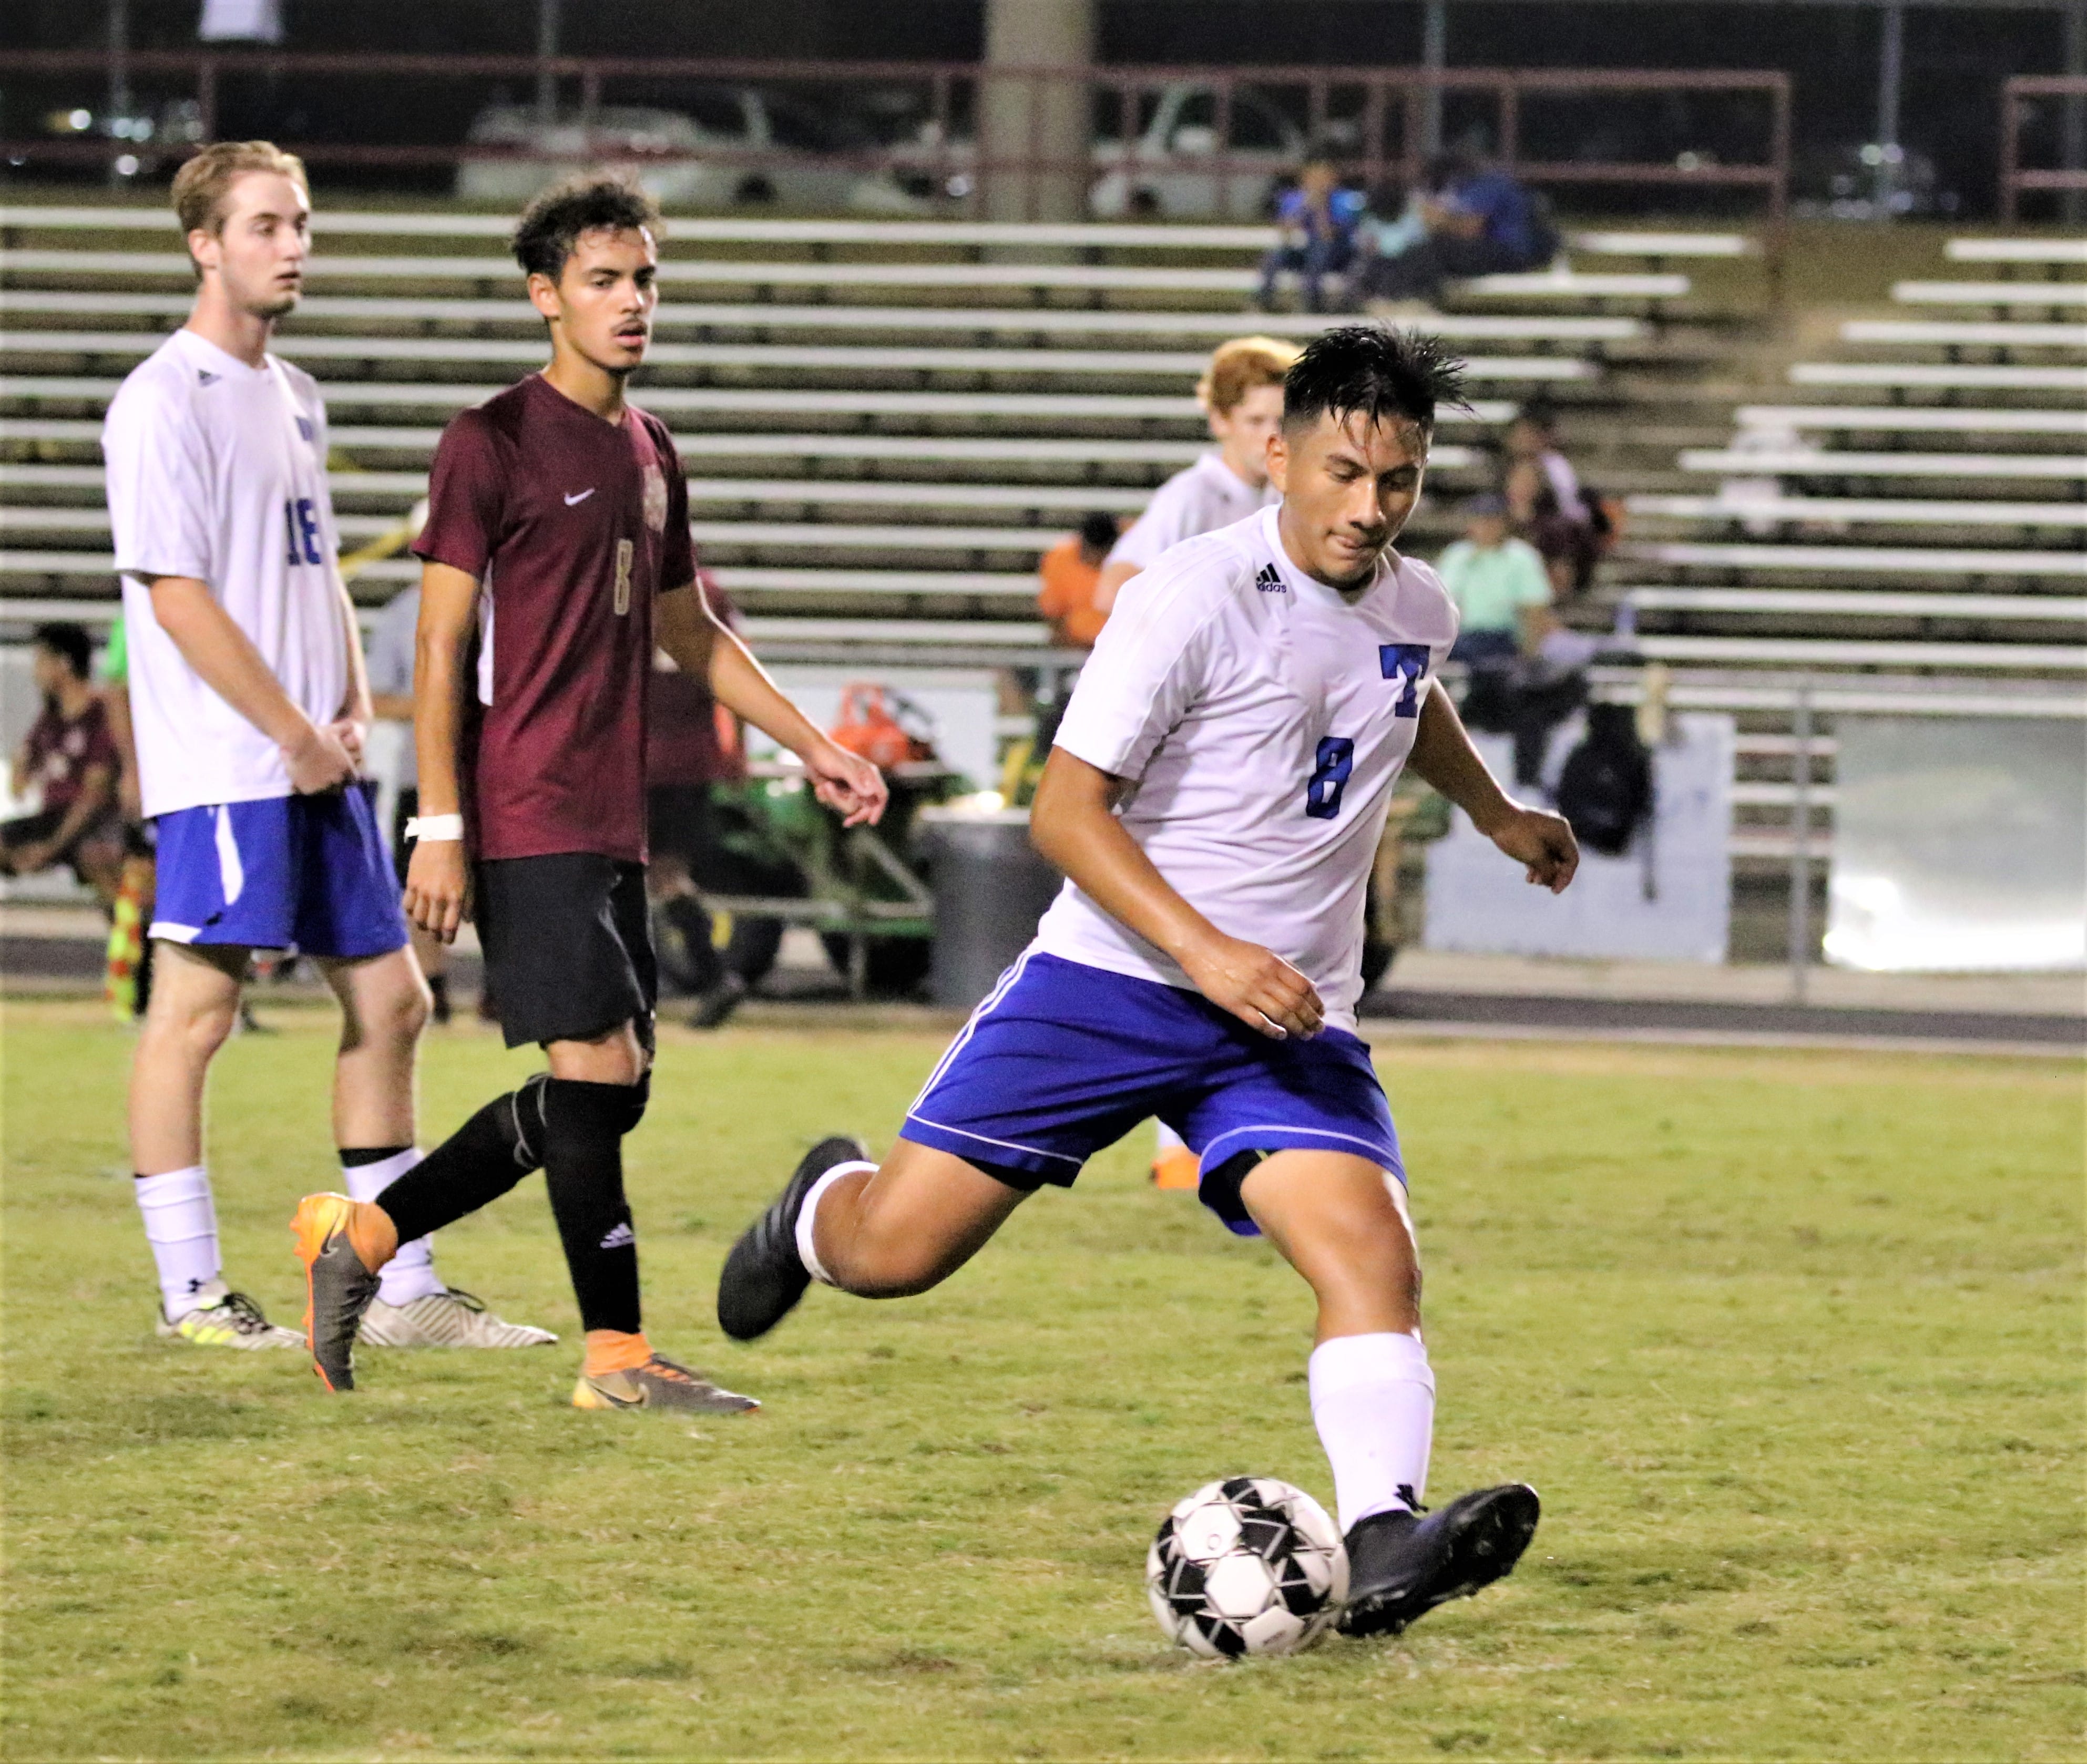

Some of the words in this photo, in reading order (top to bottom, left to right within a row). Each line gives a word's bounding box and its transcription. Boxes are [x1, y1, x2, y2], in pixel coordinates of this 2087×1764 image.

[614, 538, 633, 616] 8
[1379, 644, 1431, 718] T
[1306, 736, 1354, 819] 8
